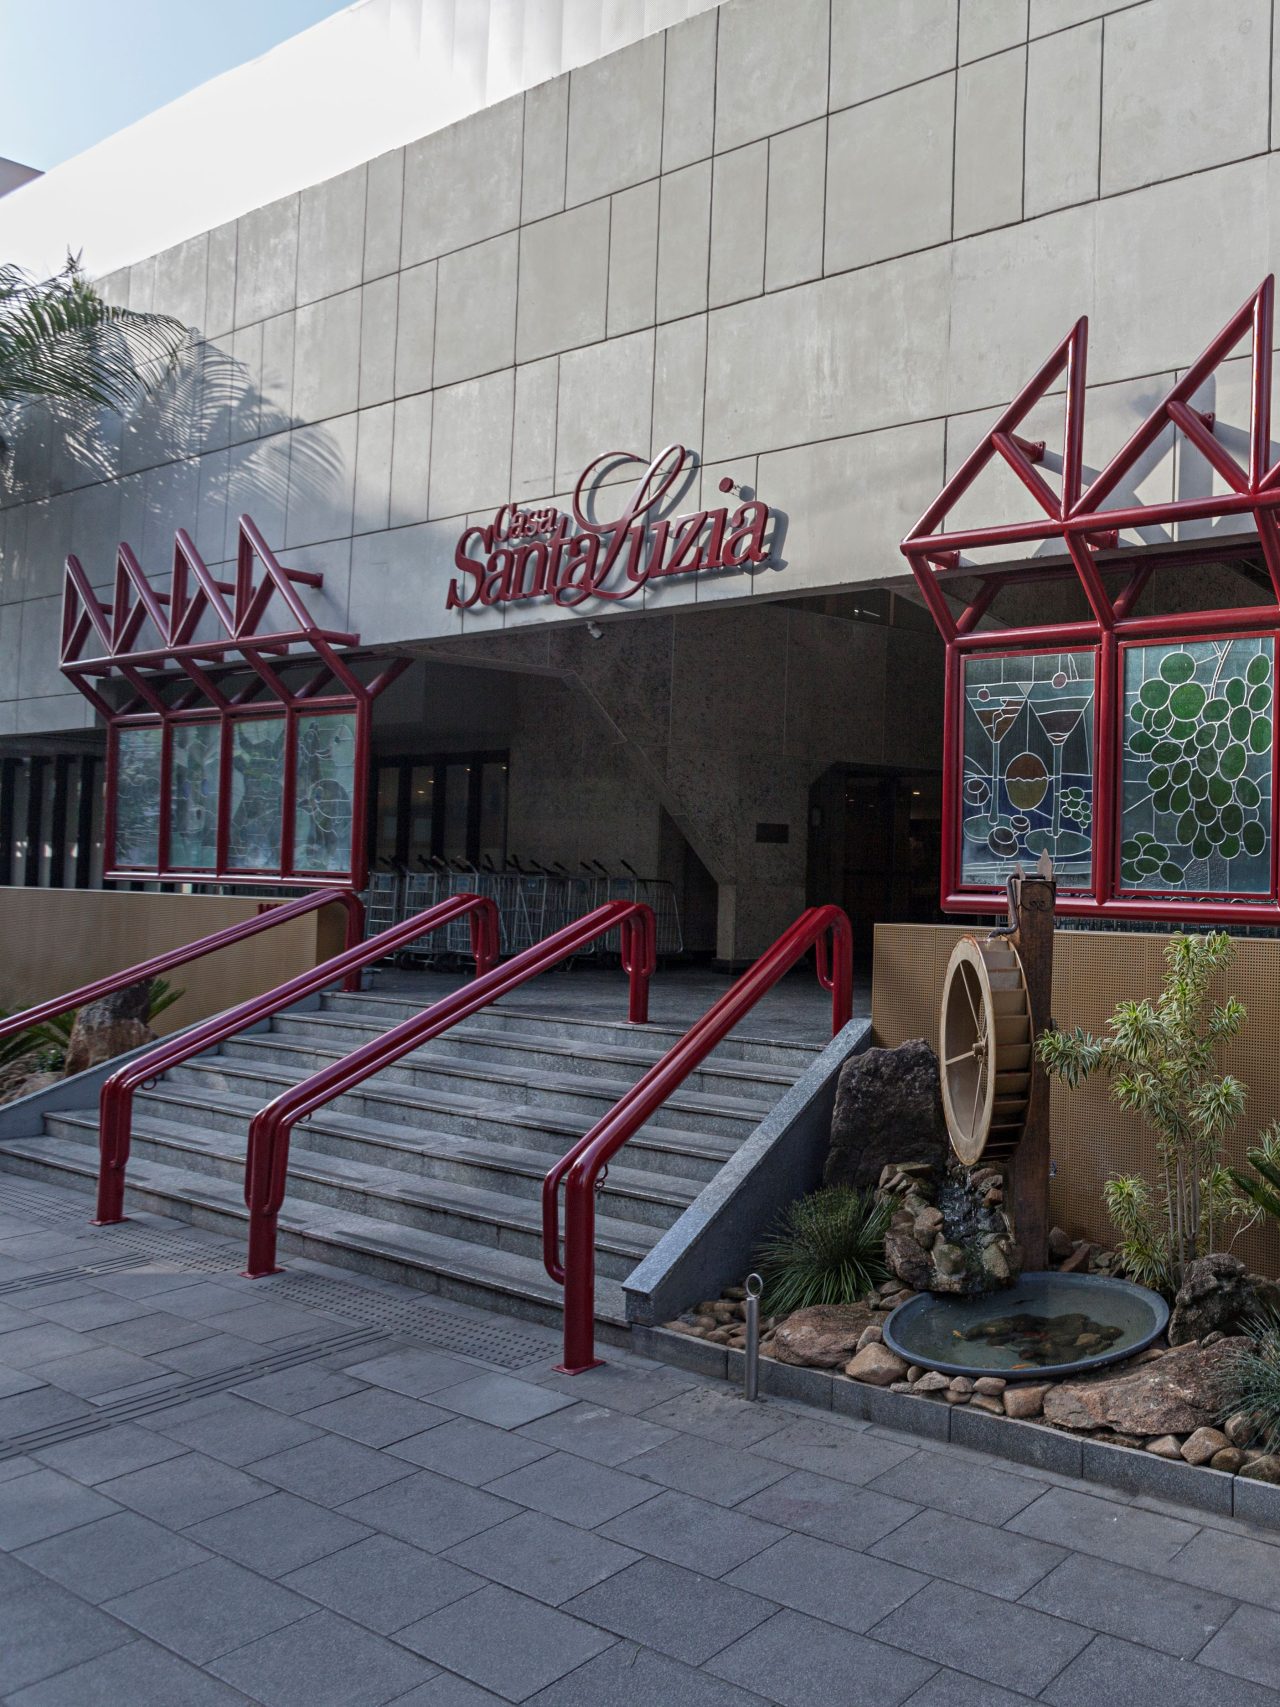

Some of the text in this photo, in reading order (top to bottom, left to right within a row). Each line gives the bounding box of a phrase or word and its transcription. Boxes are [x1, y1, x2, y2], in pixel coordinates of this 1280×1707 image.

[446, 443, 773, 609] Santa Luzia
[493, 503, 558, 542] Casa
